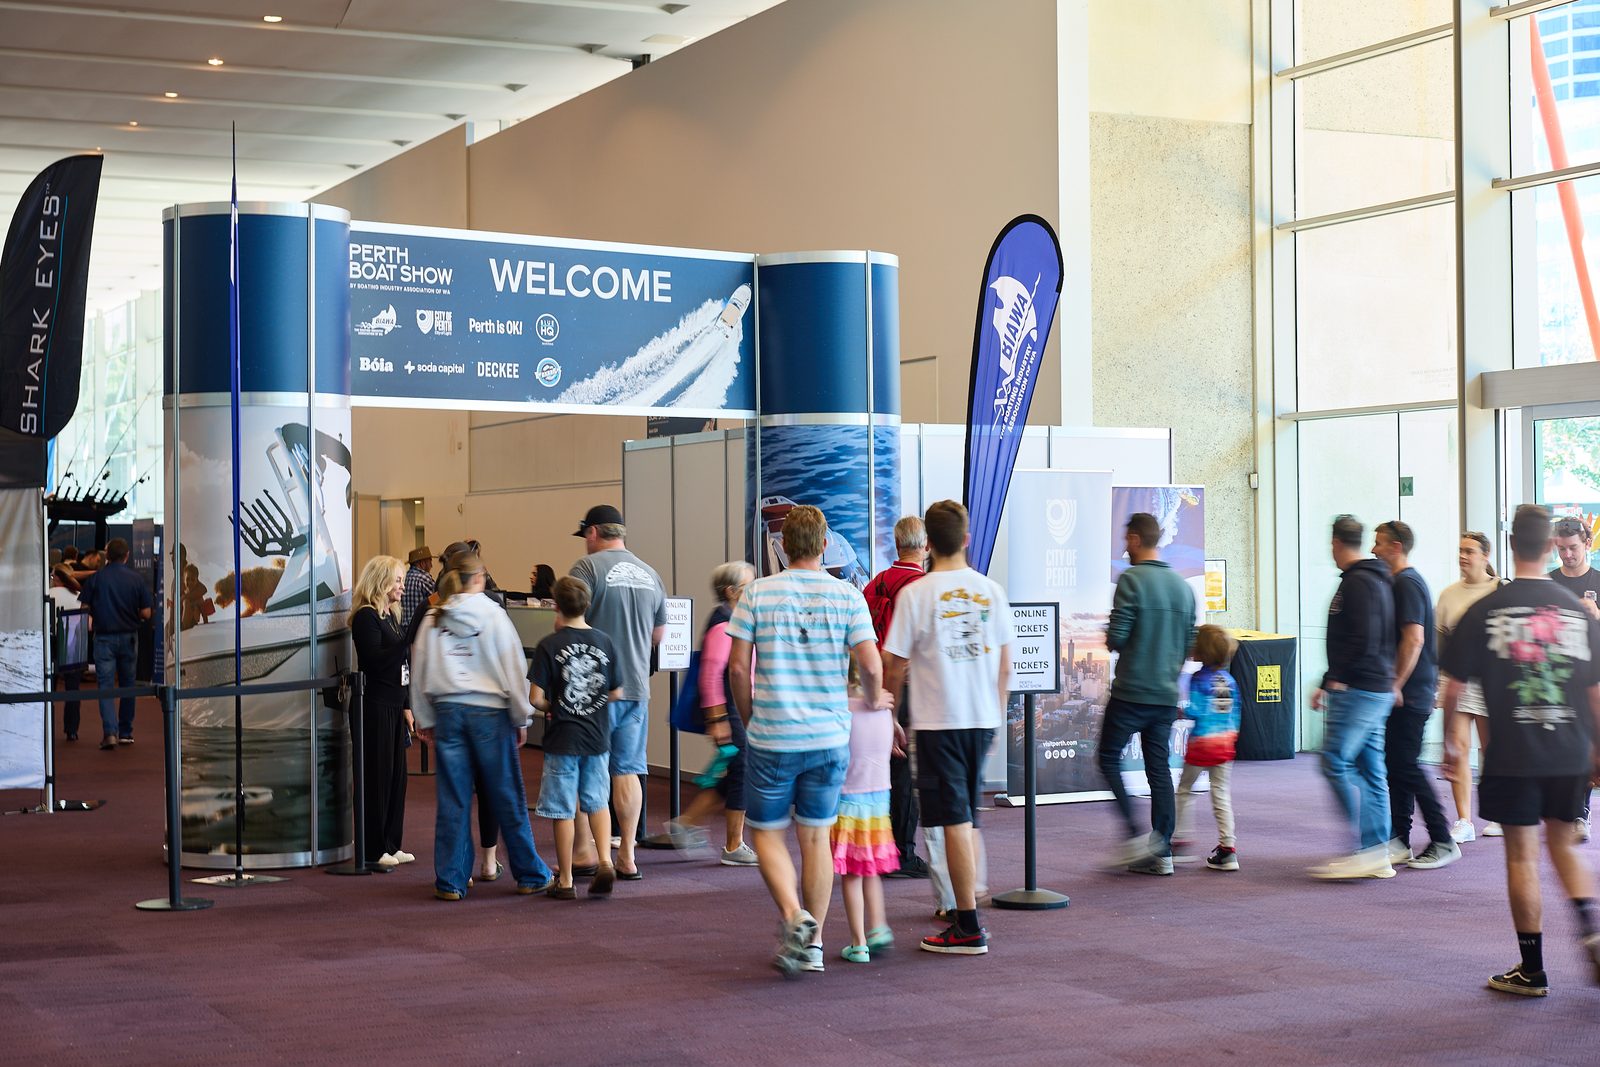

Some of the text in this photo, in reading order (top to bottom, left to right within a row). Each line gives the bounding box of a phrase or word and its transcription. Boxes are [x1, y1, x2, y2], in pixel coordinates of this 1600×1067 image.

[349, 243, 408, 264] PERTH
[349, 262, 453, 285] BOAT SHOW
[489, 258, 672, 303] WELCOME
[403, 286, 434, 294] ASSOCIATION
[434, 310, 446, 321] CITY
[434, 320, 453, 332] PERTH
[469, 317, 523, 335] Perth is OK!
[540, 326, 555, 337] HQ
[1002, 293, 1028, 361] BIAWA
[20, 307, 51, 435] SHARK
[359, 356, 394, 373] Bóia
[417, 361, 465, 376] soda capital
[477, 361, 520, 379] DECKEE
[1003, 385, 1019, 422] BOATING
[1015, 343, 1033, 385] INDUSTRY
[1007, 376, 1029, 433] ASSOCIATION
[1029, 350, 1037, 365] WA
[1046, 549, 1077, 566] CITY OF
[1046, 567, 1077, 587] PERTH
[666, 601, 687, 609] ONLINE
[1013, 609, 1047, 618] ONLINE
[1013, 624, 1049, 633] TICKETS
[1022, 646, 1040, 654] BUY
[1012, 661, 1049, 670] TICKETS
[1042, 740, 1078, 748] visitperth.com
